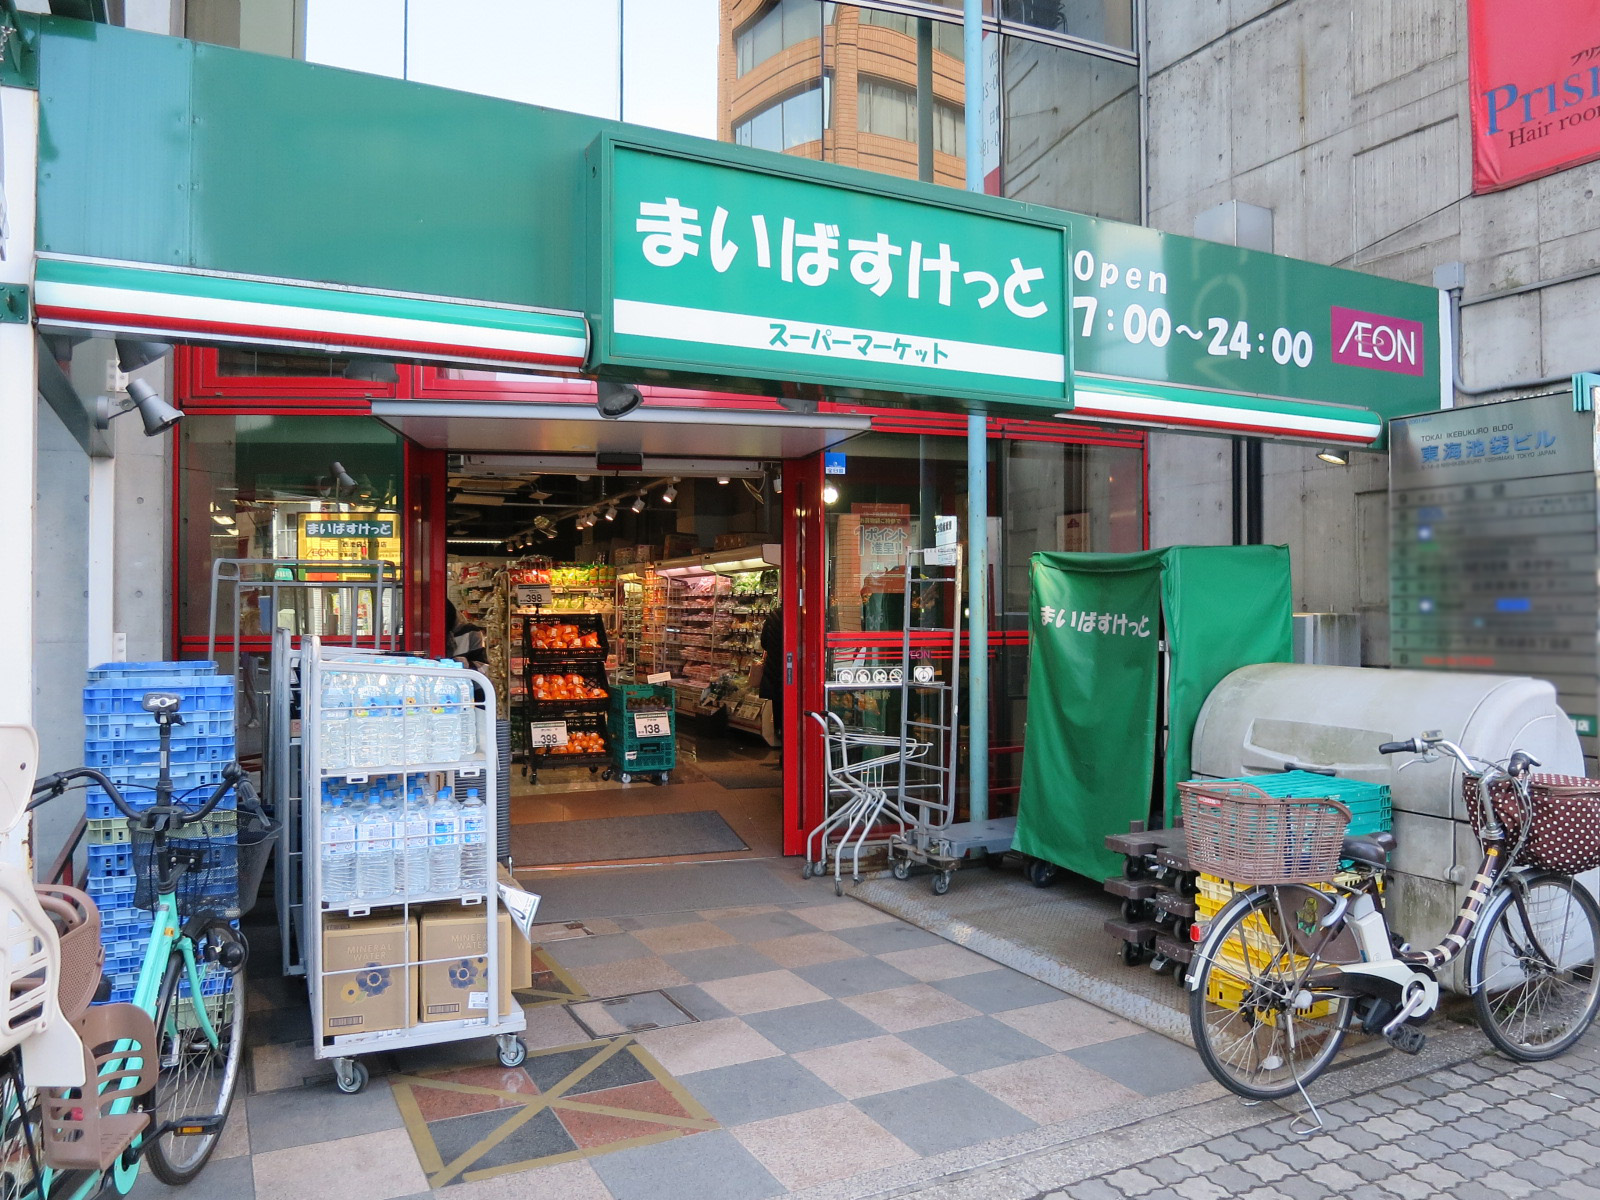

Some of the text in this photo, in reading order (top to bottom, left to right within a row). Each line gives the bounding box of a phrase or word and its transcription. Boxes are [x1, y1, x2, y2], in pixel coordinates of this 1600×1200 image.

[1508, 121, 1553, 149] Hair
[636, 197, 1049, 319] まいばすけっと
[1074, 250, 1168, 294] Open
[769, 323, 949, 365] スーパーマーケット
[1421, 423, 1514, 442] TOKAI IKEBUKURO BLDG
[1420, 429, 1556, 464] 東海池袋ビル
[307, 522, 391, 535] まいばすけっと
[865, 526, 908, 541] ポイント
[526, 593, 542, 603] 398
[1040, 605, 1150, 638] まいばすけっと
[643, 723, 660, 734] 138
[540, 733, 558, 744] 398
[451, 933, 487, 943] MINER
[347, 943, 393, 954] MINERAL
[456, 941, 487, 950] WATE
[353, 951, 386, 961] WATER
